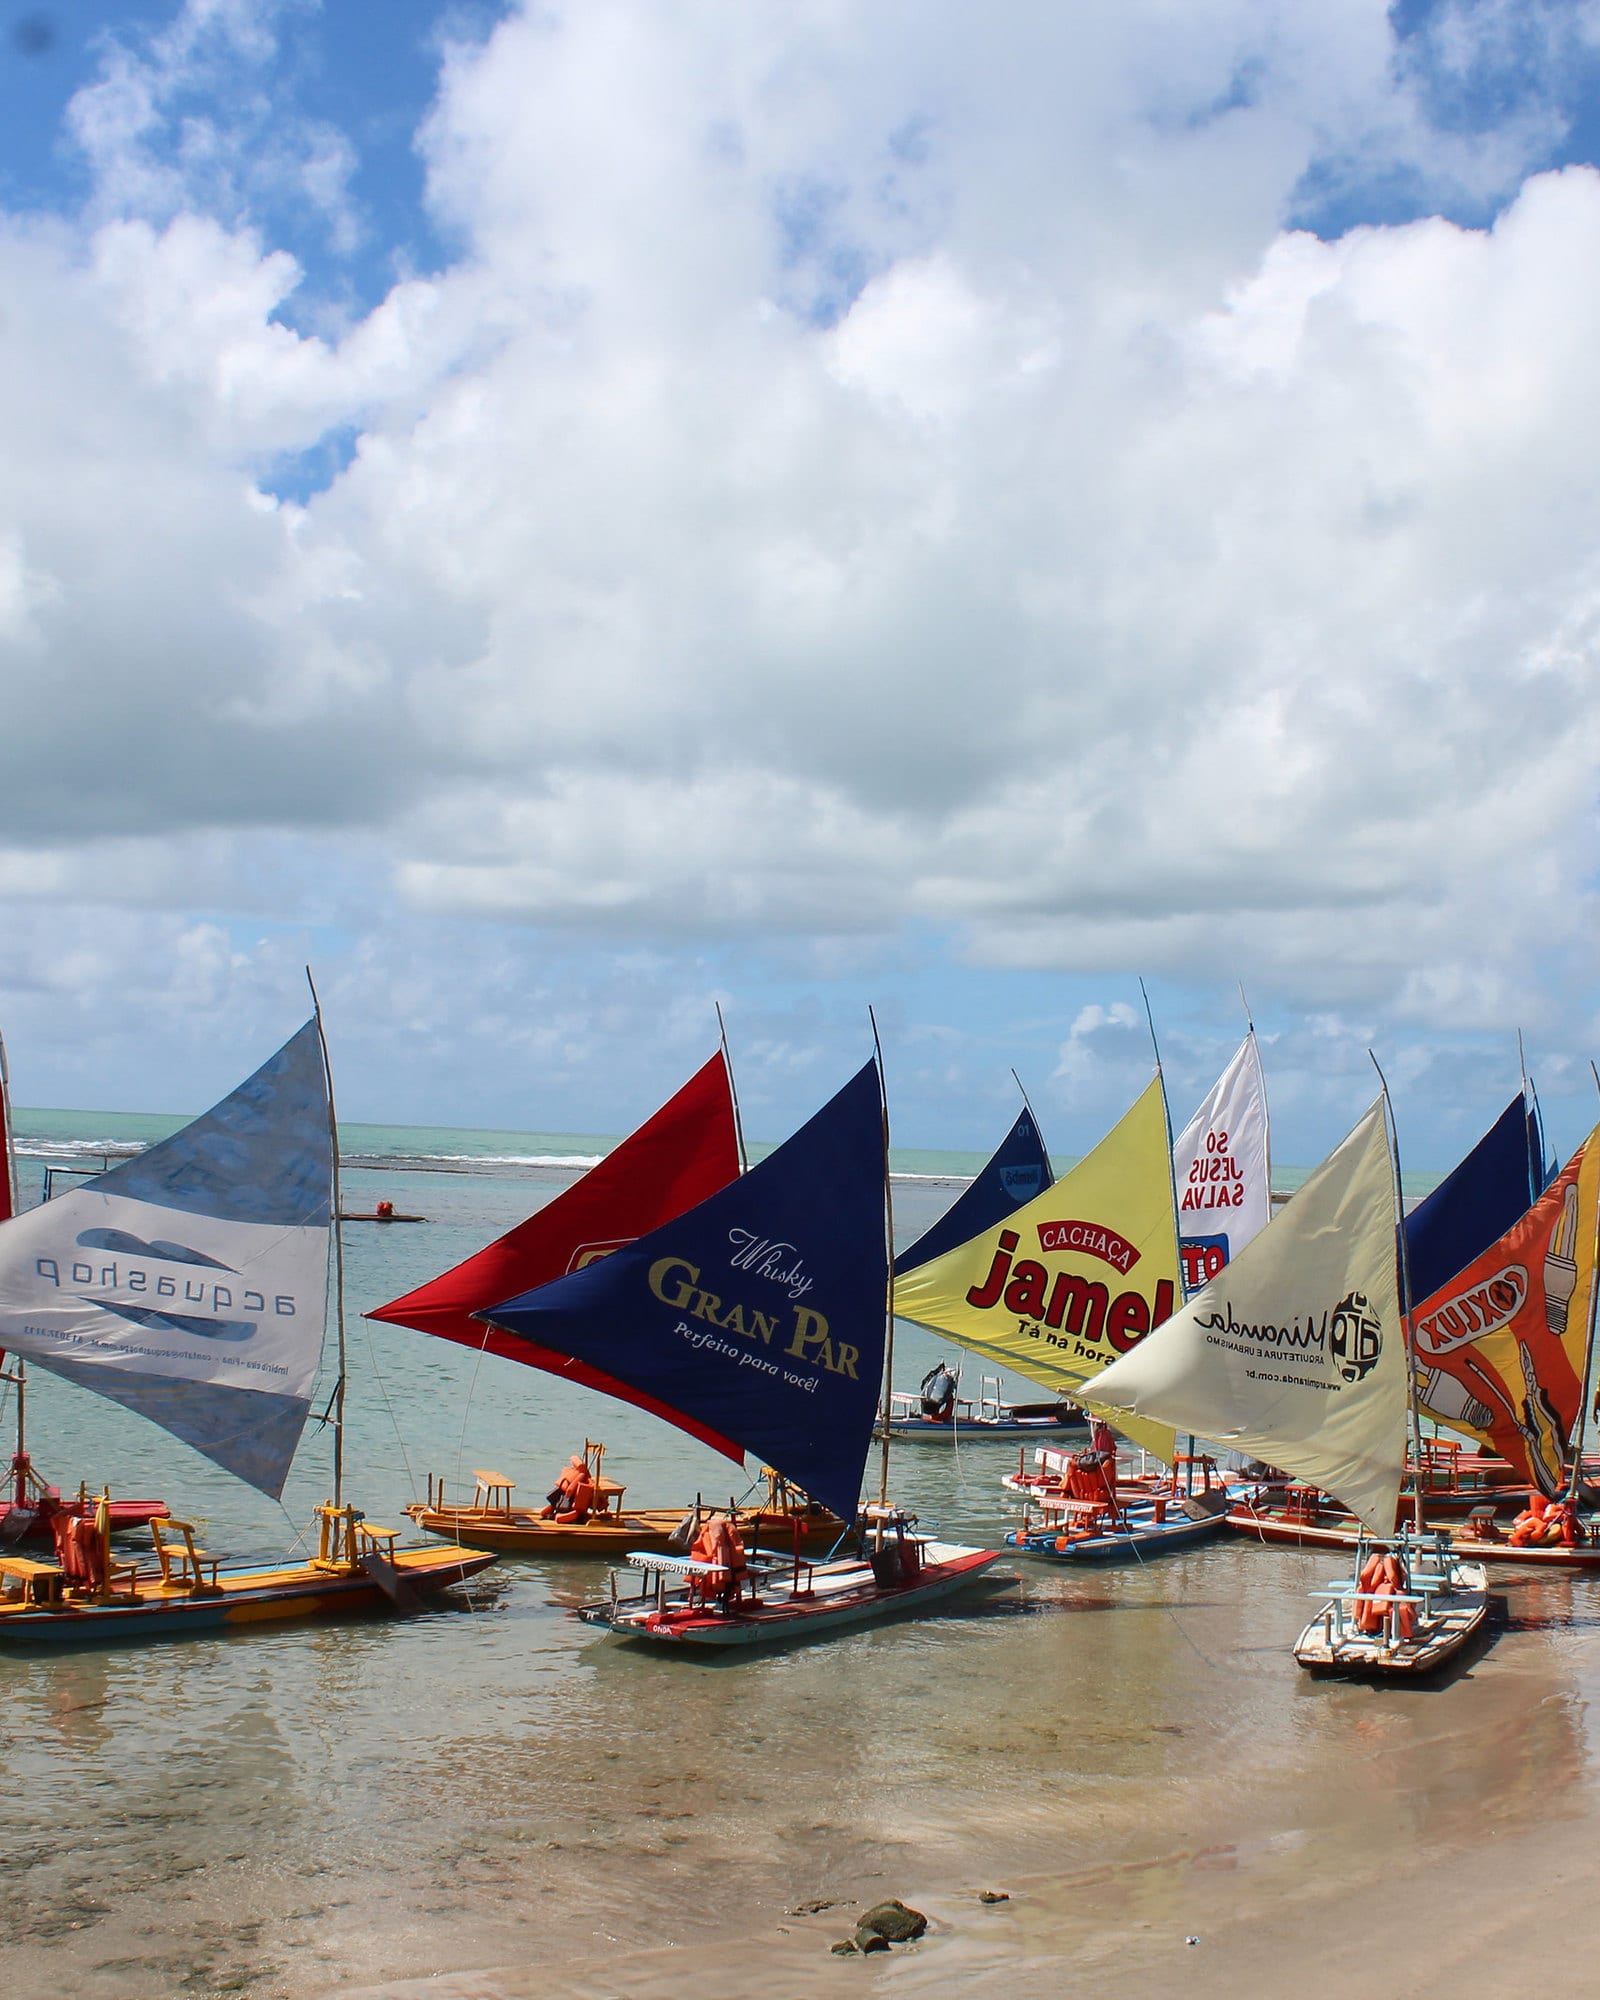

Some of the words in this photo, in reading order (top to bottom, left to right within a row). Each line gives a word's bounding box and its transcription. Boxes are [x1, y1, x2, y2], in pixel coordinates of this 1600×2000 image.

[1017, 1124, 1030, 1137] 01
[728, 1228, 813, 1299] Whisky
[1042, 1226, 1131, 1270] CACHAÇA
[648, 1256, 780, 1345] GRAN
[783, 1304, 860, 1380] PAR
[1017, 1319, 1041, 1339] Tá
[1046, 1333, 1069, 1350] na
[1073, 1341, 1116, 1366] hora
[673, 1321, 739, 1358] Perfeito
[739, 1352, 779, 1376] para
[783, 1370, 820, 1393] você!
